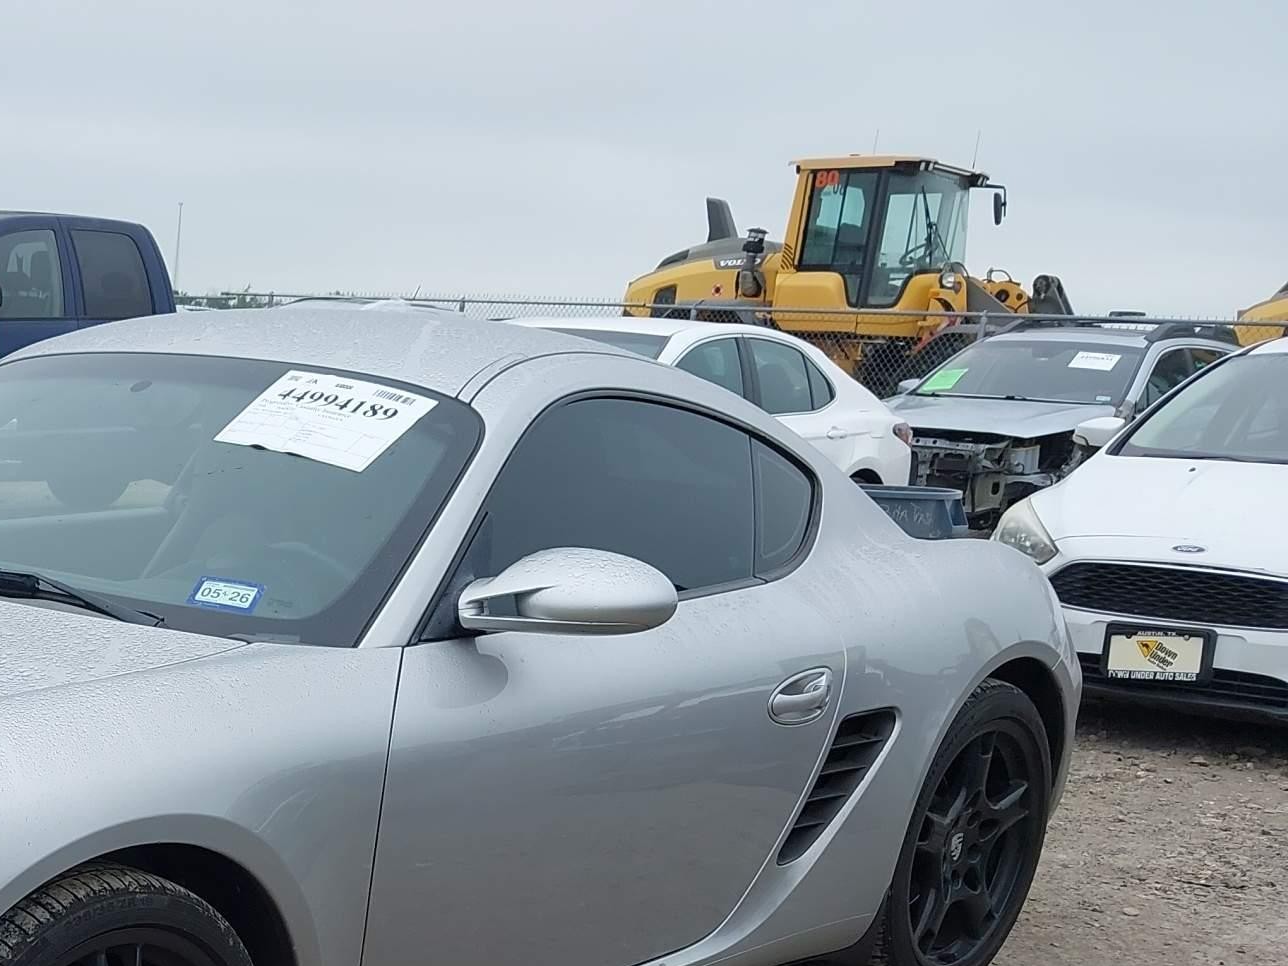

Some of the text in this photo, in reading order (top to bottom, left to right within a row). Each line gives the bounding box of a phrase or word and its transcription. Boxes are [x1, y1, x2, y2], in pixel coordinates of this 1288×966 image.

[719, 257, 761, 267] VOLO
[277, 387, 399, 421] 44994189
[1149, 651, 1174, 668] Under
[1154, 641, 1179, 661] Down
[1131, 671, 1155, 680] UNDER
[1155, 671, 1174, 680] AUTO
[1174, 672, 1197, 681] SALES
